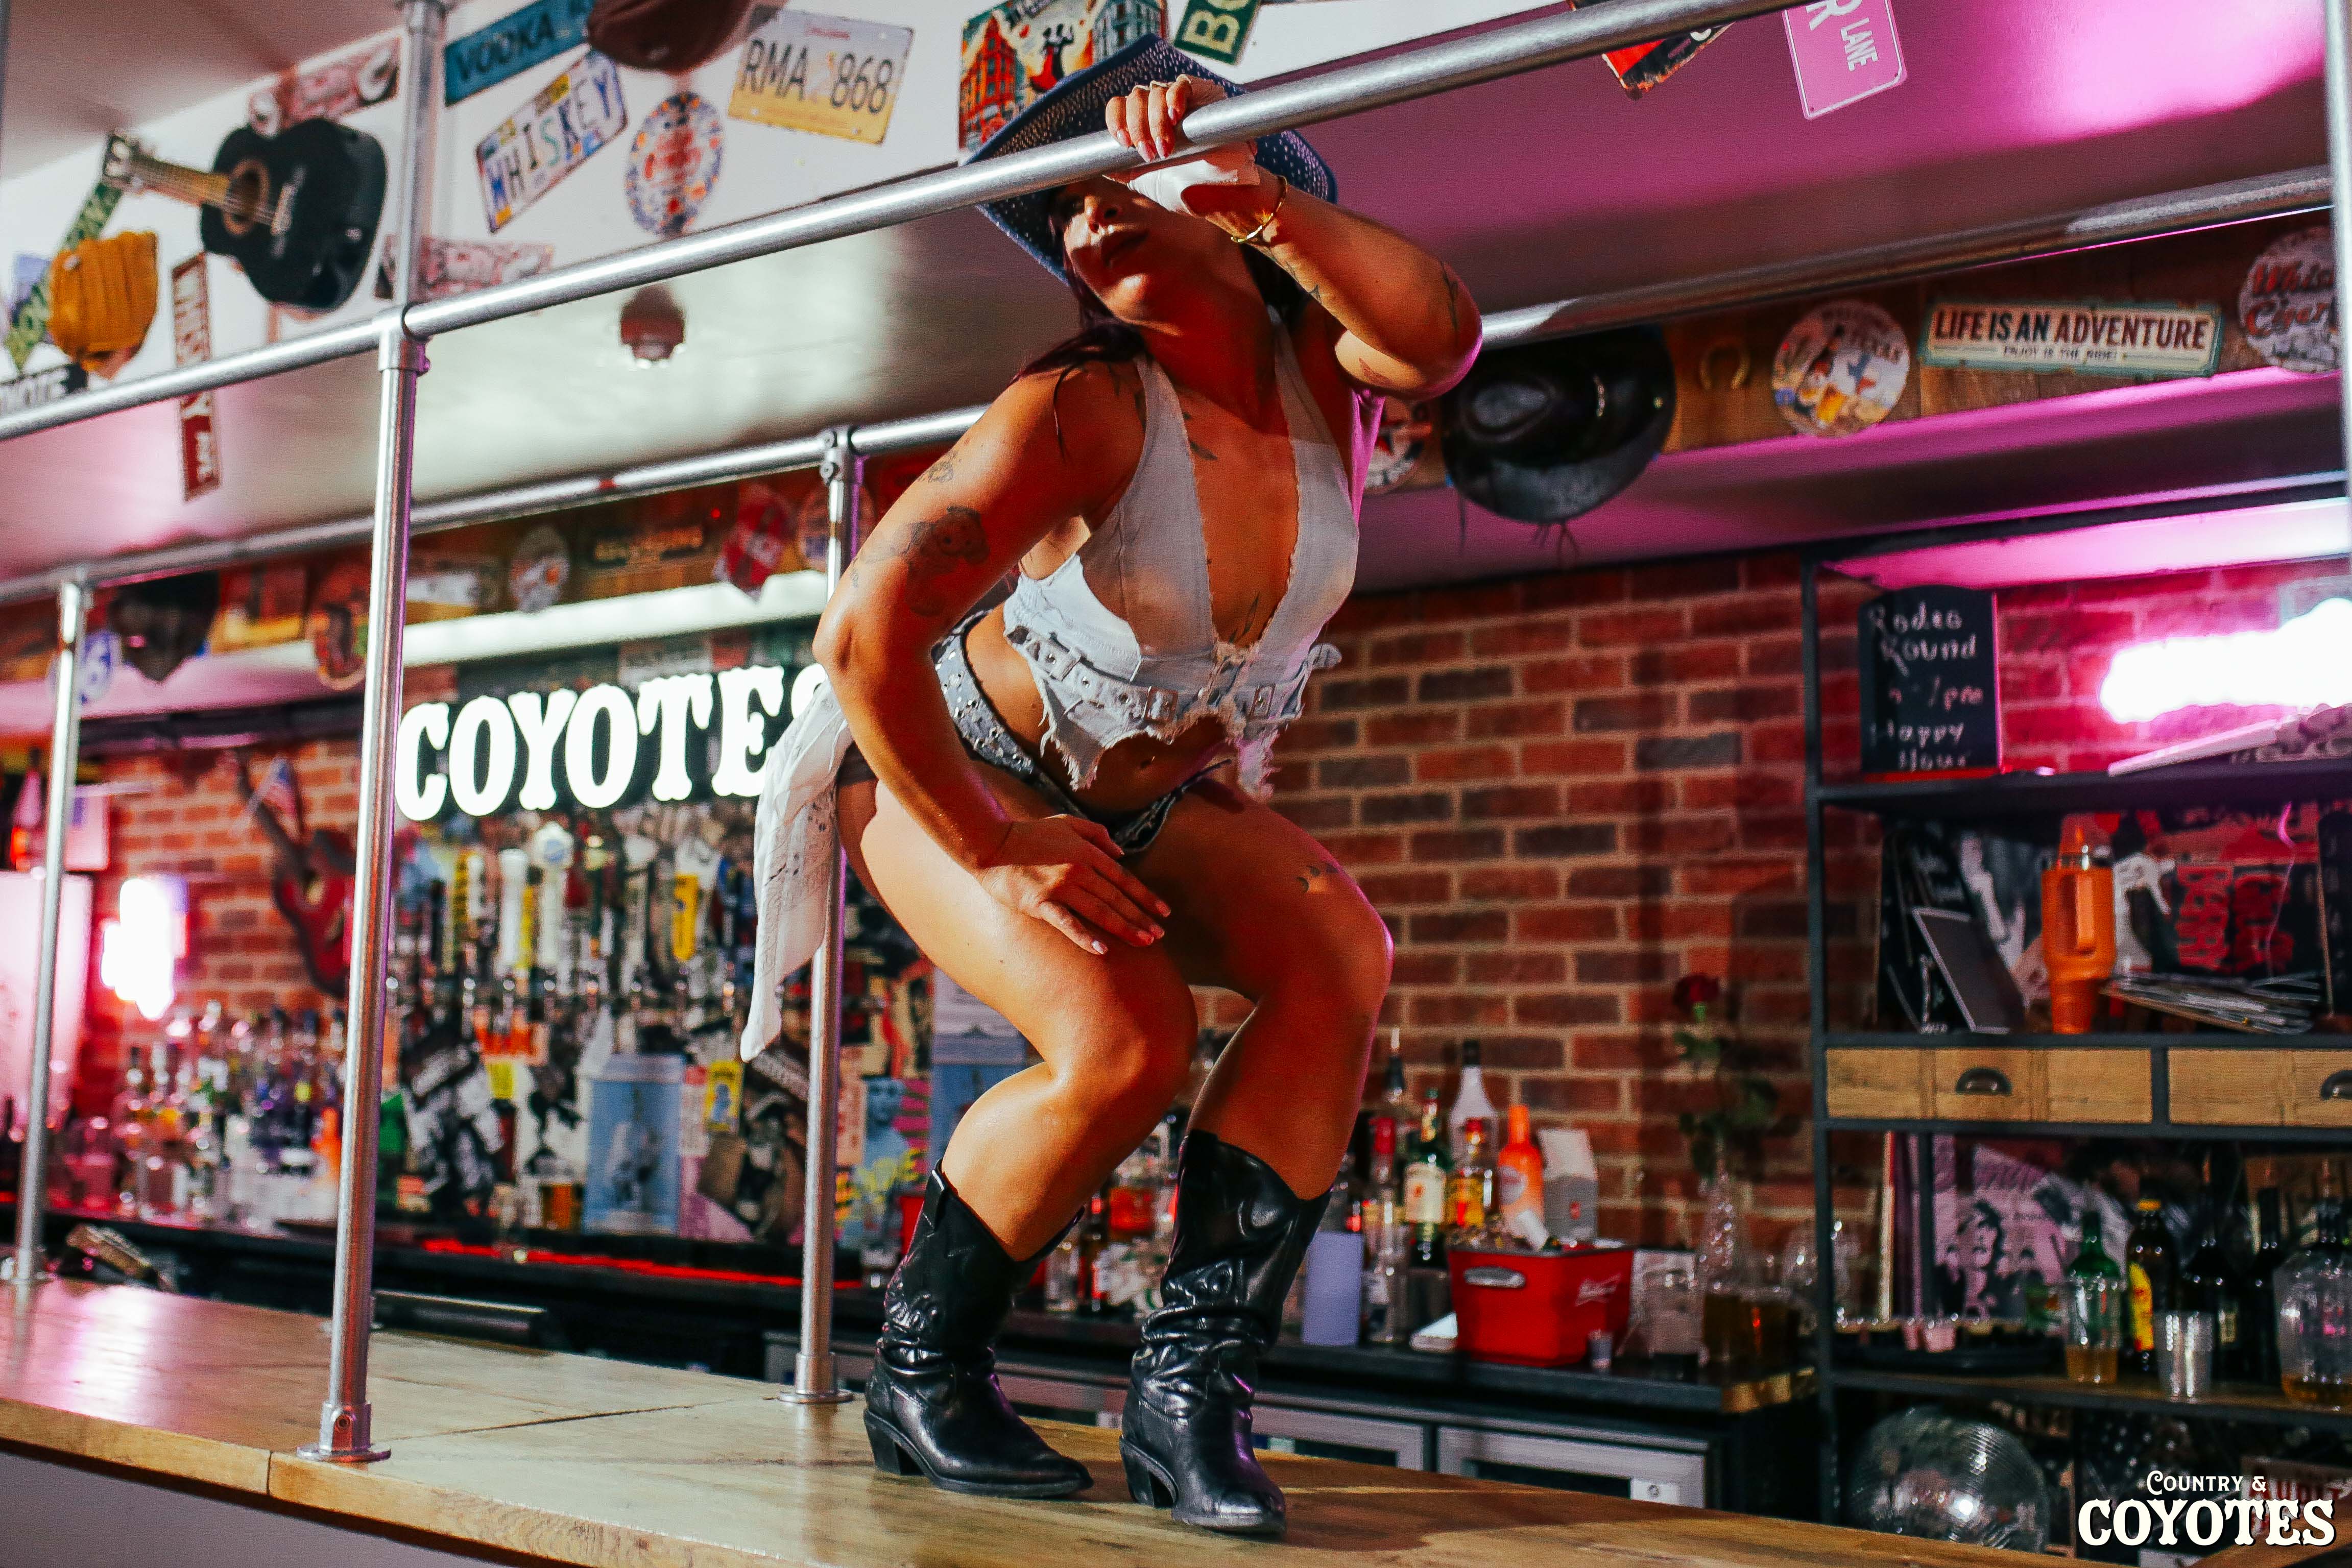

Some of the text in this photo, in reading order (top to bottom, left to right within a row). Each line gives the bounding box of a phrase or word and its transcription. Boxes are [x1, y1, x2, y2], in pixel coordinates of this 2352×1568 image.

[456, 12, 556, 82] VODKA
[1840, 17, 1878, 72] LANE
[738, 38, 895, 114] RMA 868
[484, 67, 612, 209] WHISKEY
[2251, 260, 2336, 298] Whis
[1934, 309, 2211, 351] LIFE IS AN ADVENTURE
[1867, 600, 1963, 635] Rodeo
